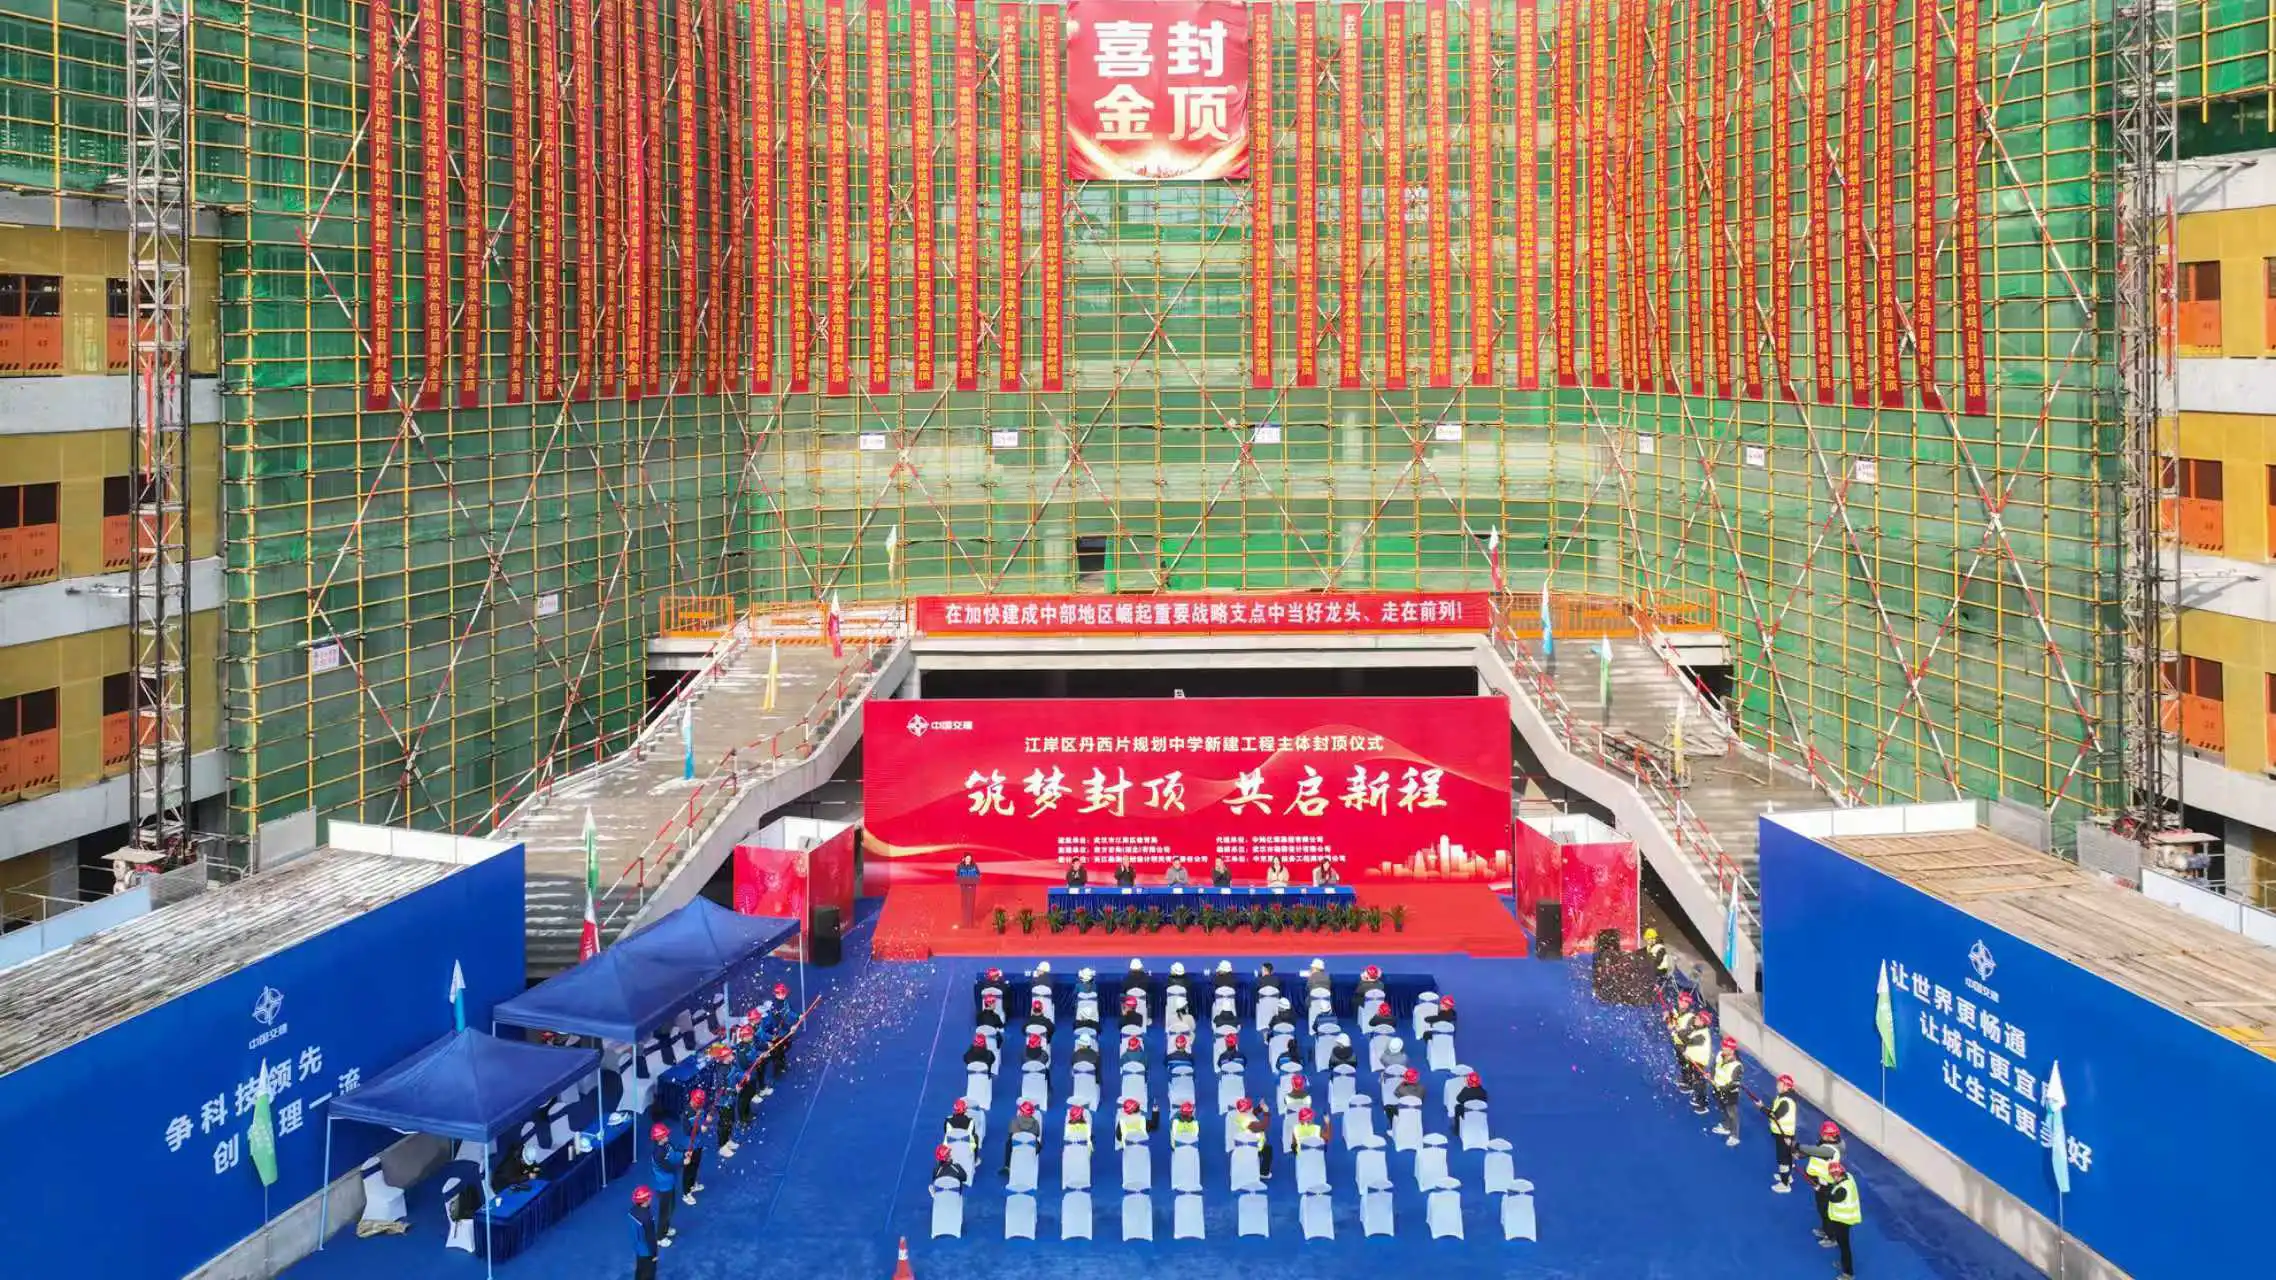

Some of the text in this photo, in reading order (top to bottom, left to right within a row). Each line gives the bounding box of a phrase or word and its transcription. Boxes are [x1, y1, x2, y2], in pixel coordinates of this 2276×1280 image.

[1093, 19, 1228, 78] 喜封
[1094, 84, 1230, 141] 金顶
[945, 600, 1464, 626] 在加快建成中部地区崛起重要战略支点中当好龙头、走在前列！
[930, 720, 974, 731] 中国交建
[1024, 735, 1384, 753] 江岸区丹西片规划中学新建工程主体封顶仪式
[964, 764, 1449, 818] 筑梦封顶 共启新程
[1890, 960, 2027, 1059] 让世界更畅通
[165, 1046, 323, 1153] 争科技领先
[212, 1067, 362, 1175] 创理一流
